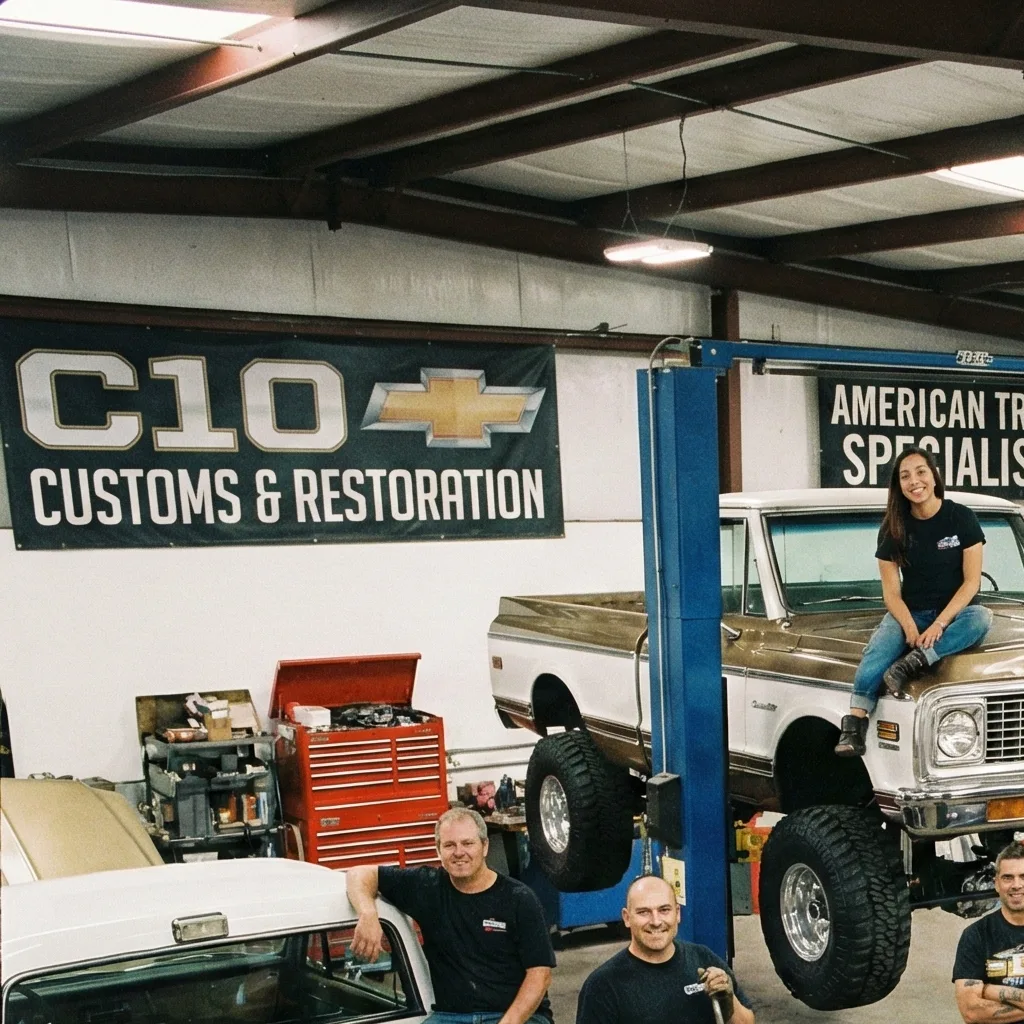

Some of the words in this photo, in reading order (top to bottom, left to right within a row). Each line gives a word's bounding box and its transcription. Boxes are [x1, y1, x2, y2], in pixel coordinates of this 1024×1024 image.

[15, 348, 348, 453] C10
[831, 384, 985, 429] AMERICAN
[30, 467, 239, 526] CUSTOMS
[256, 468, 282, 523] &
[293, 467, 546, 523] RESTORATION
